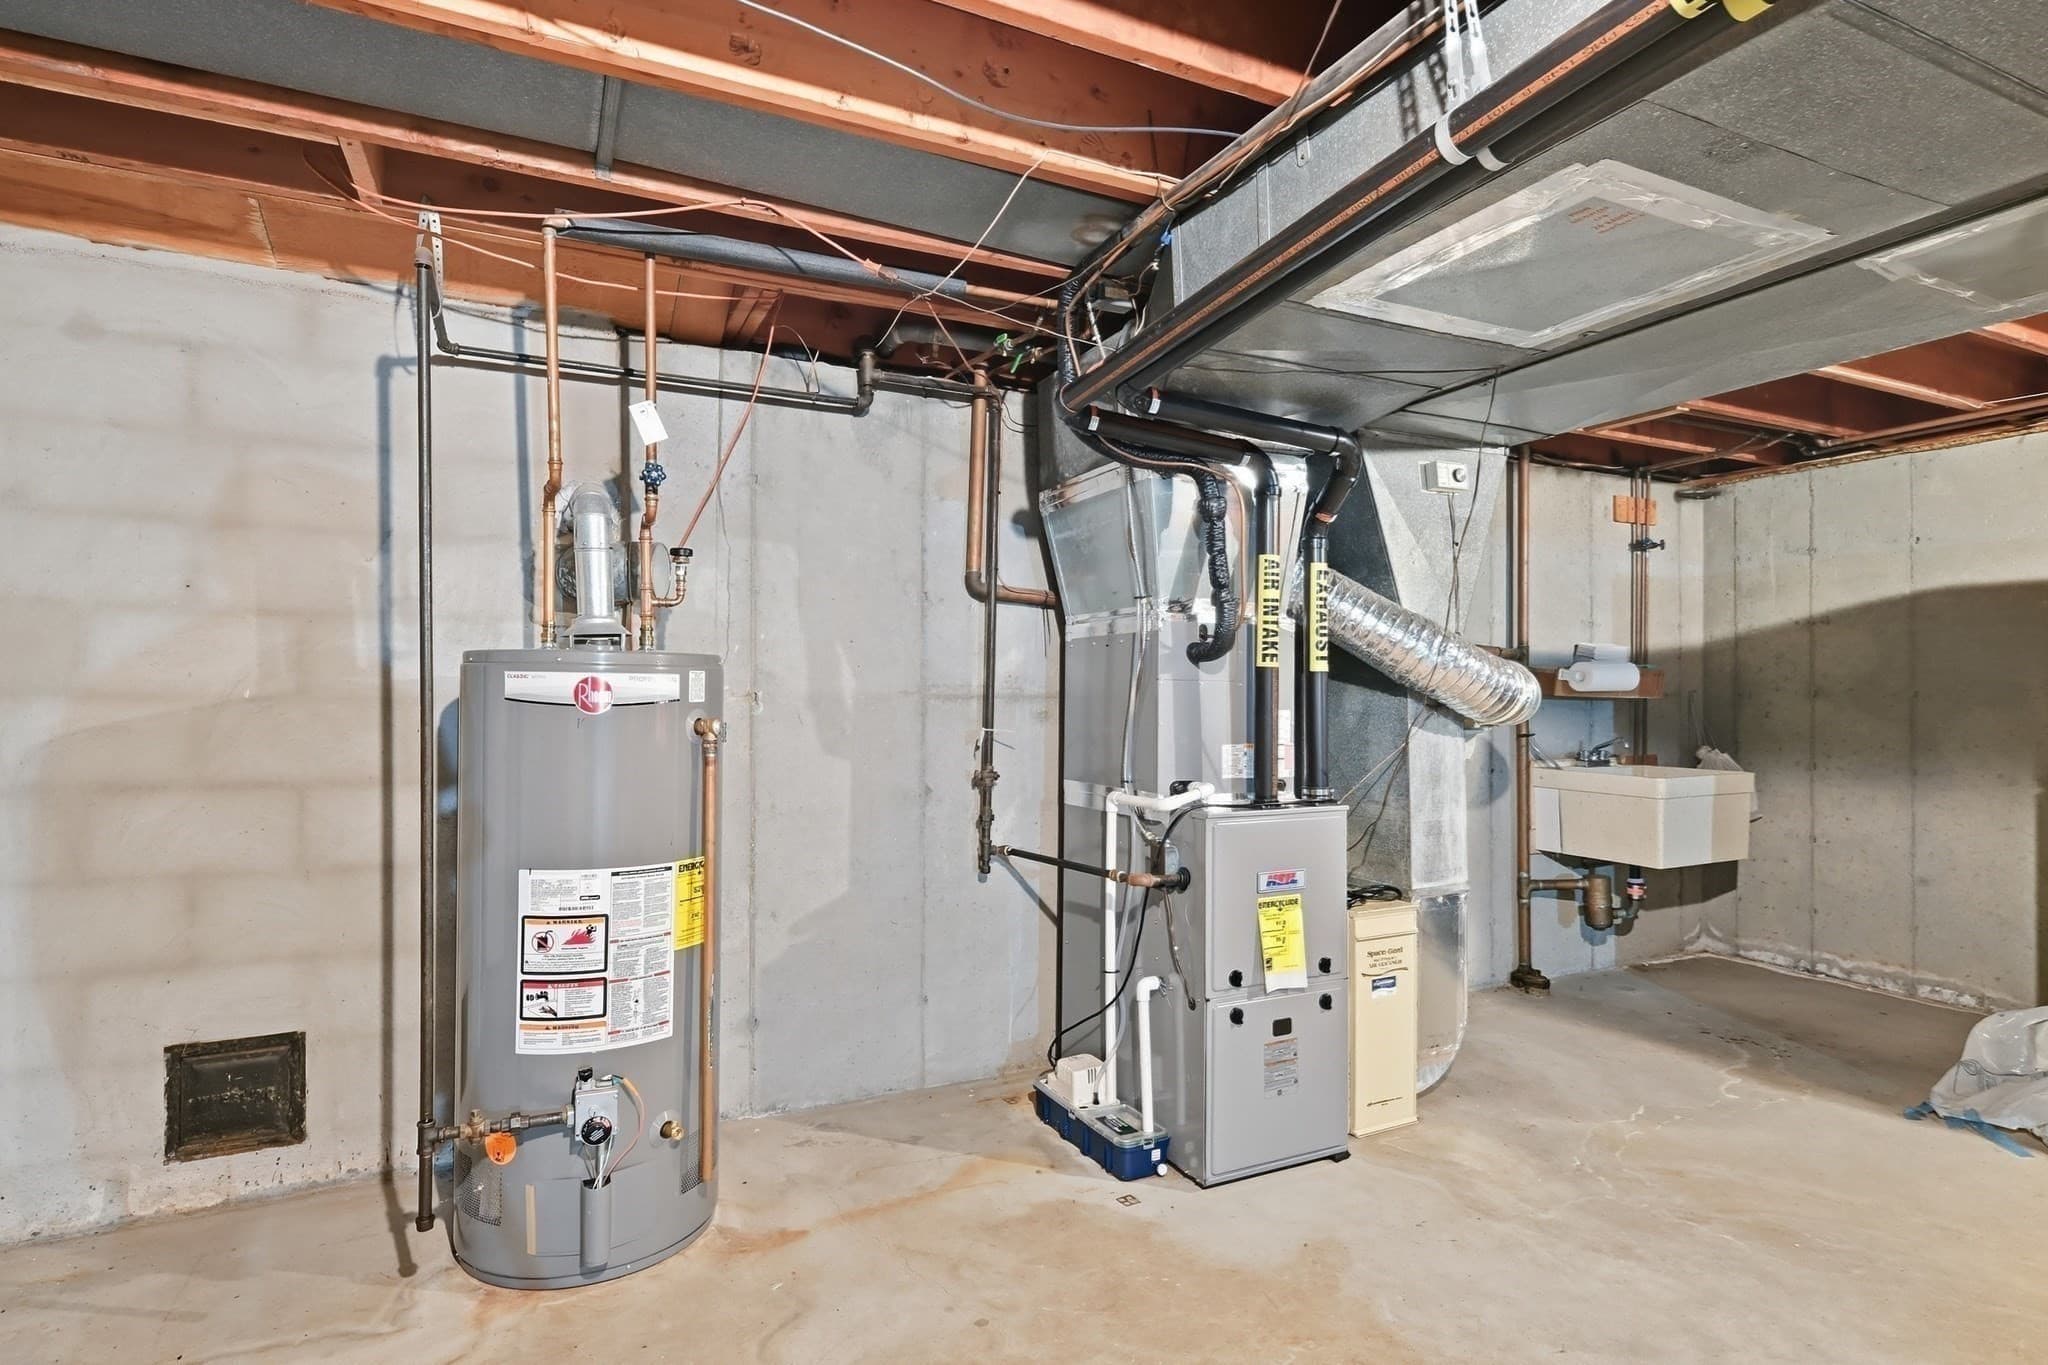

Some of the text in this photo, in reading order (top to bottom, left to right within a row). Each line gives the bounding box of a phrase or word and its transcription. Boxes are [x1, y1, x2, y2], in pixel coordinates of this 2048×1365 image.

[1262, 559, 1279, 662] AIR INTAKE
[578, 677, 611, 708] Rhem
